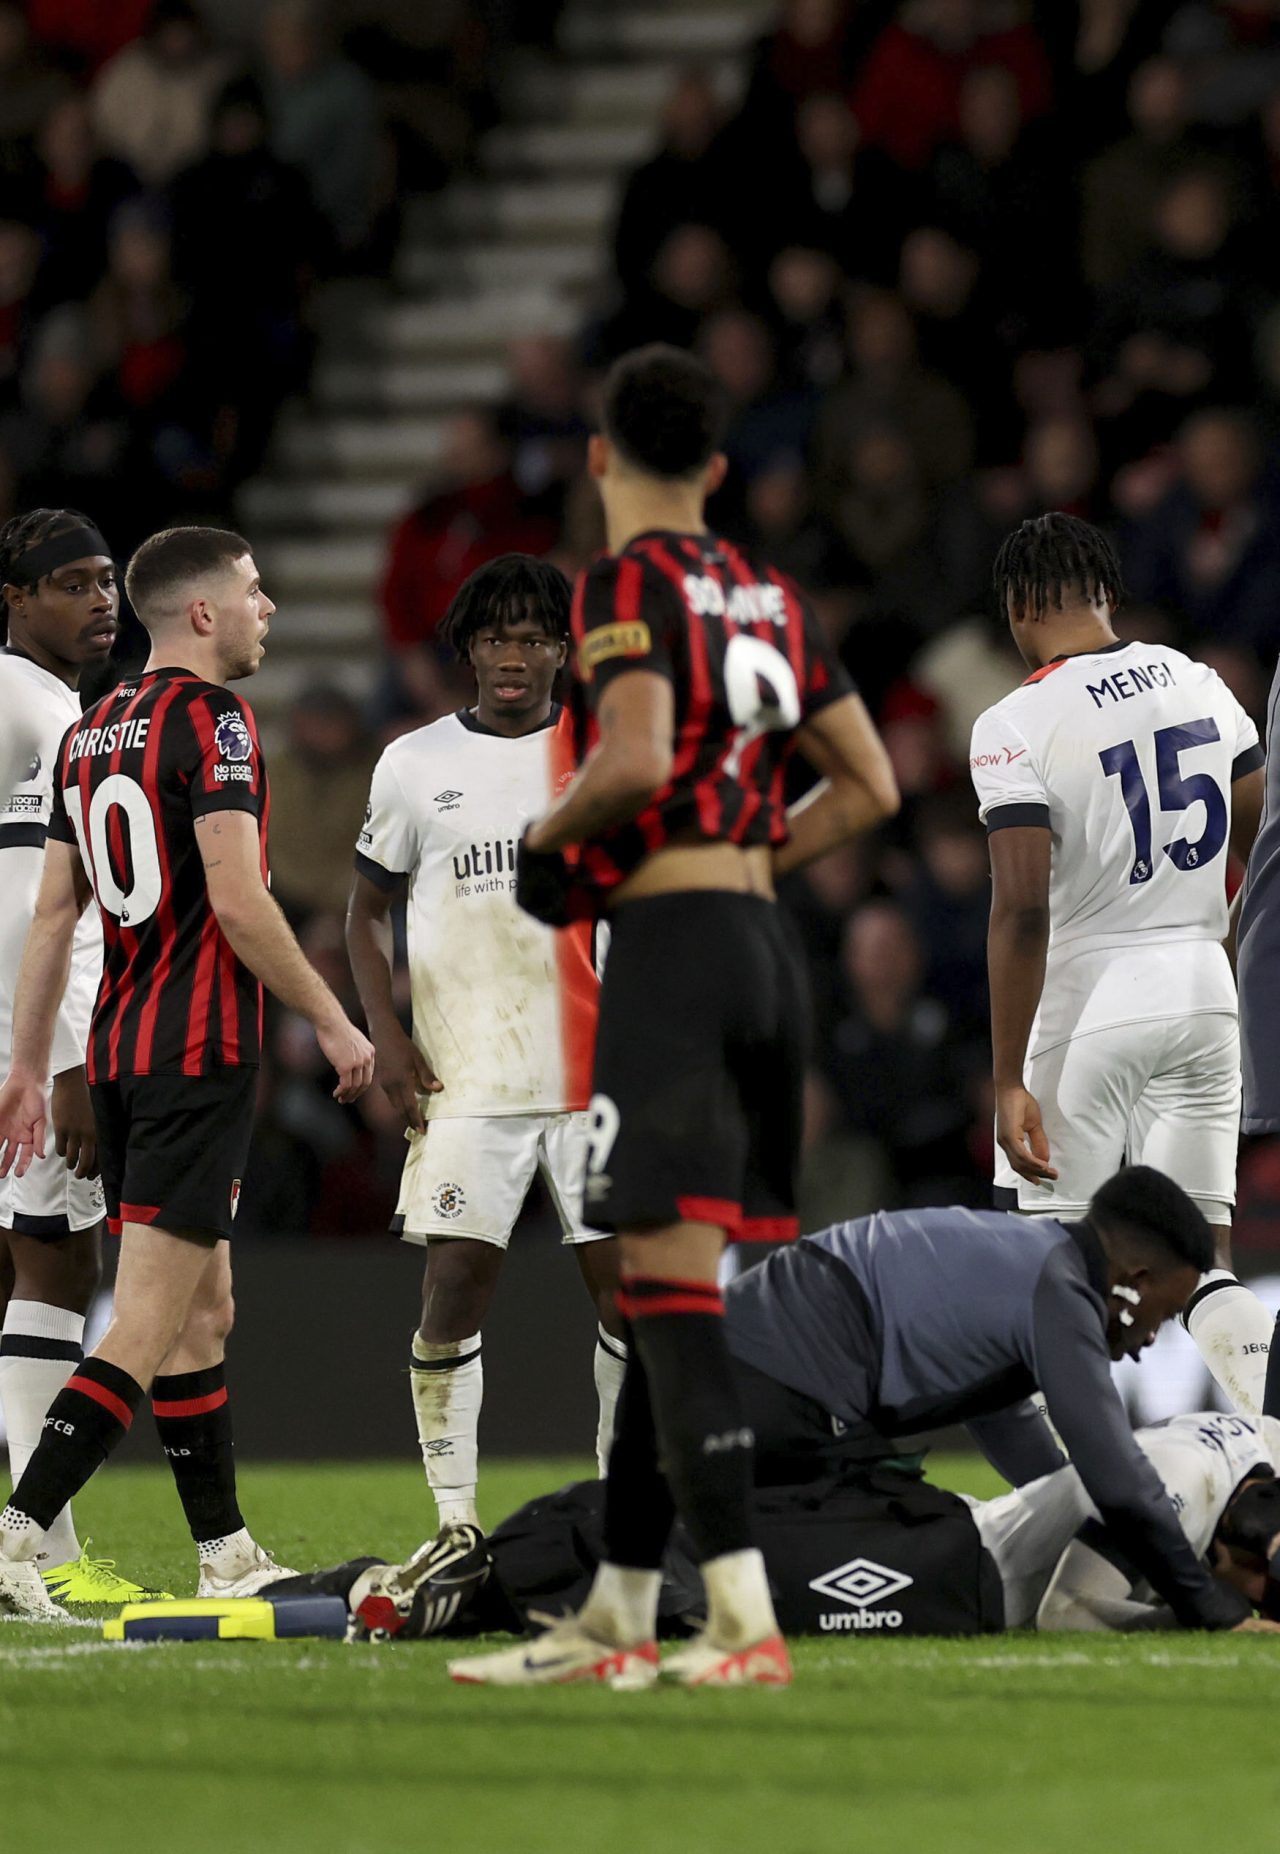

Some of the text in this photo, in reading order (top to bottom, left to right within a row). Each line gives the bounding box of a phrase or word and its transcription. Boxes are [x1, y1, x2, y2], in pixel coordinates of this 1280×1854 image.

[118, 687, 137, 698] AFCB
[1085, 662, 1177, 708] MENGI
[69, 718, 151, 763] CHRISTIE
[213, 764, 230, 774] No
[437, 803, 461, 813] umbro
[1098, 717, 1228, 885] 15
[63, 773, 162, 928] 10
[455, 883, 471, 899] life
[474, 877, 505, 893] with
[590, 1092, 621, 1174] 9
[819, 1608, 903, 1631] umbro
